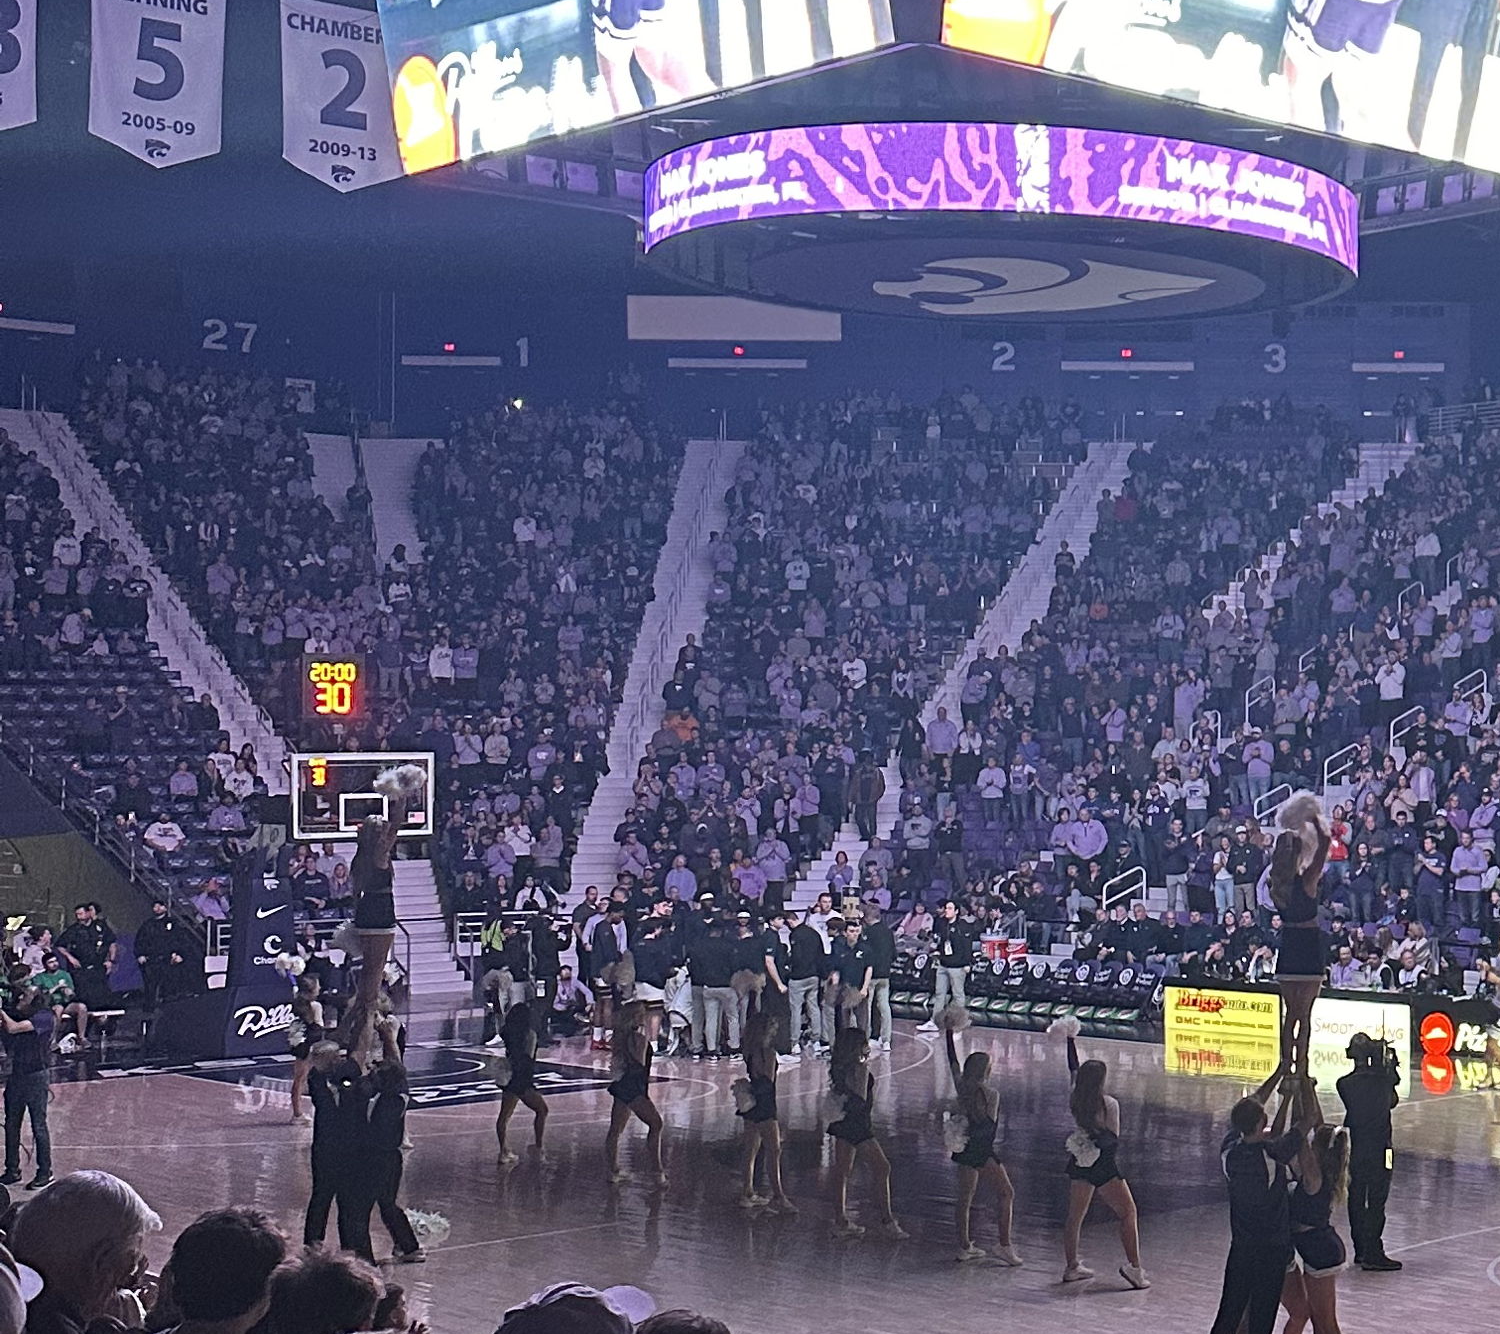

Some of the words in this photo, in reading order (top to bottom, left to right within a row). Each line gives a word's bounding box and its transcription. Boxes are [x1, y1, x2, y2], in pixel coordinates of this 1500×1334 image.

[132, 17, 185, 101] 5
[319, 48, 367, 131] 2
[121, 111, 196, 136] 2005-09
[308, 138, 377, 162] 2009-13
[1164, 155, 1231, 191] MAX
[1233, 168, 1305, 209] JONES
[203, 318, 258, 353] 27
[515, 337, 529, 366] 1
[992, 342, 1016, 371] 2
[1264, 343, 1287, 373] 3
[309, 662, 356, 682] 20:00
[315, 682, 352, 714] 30
